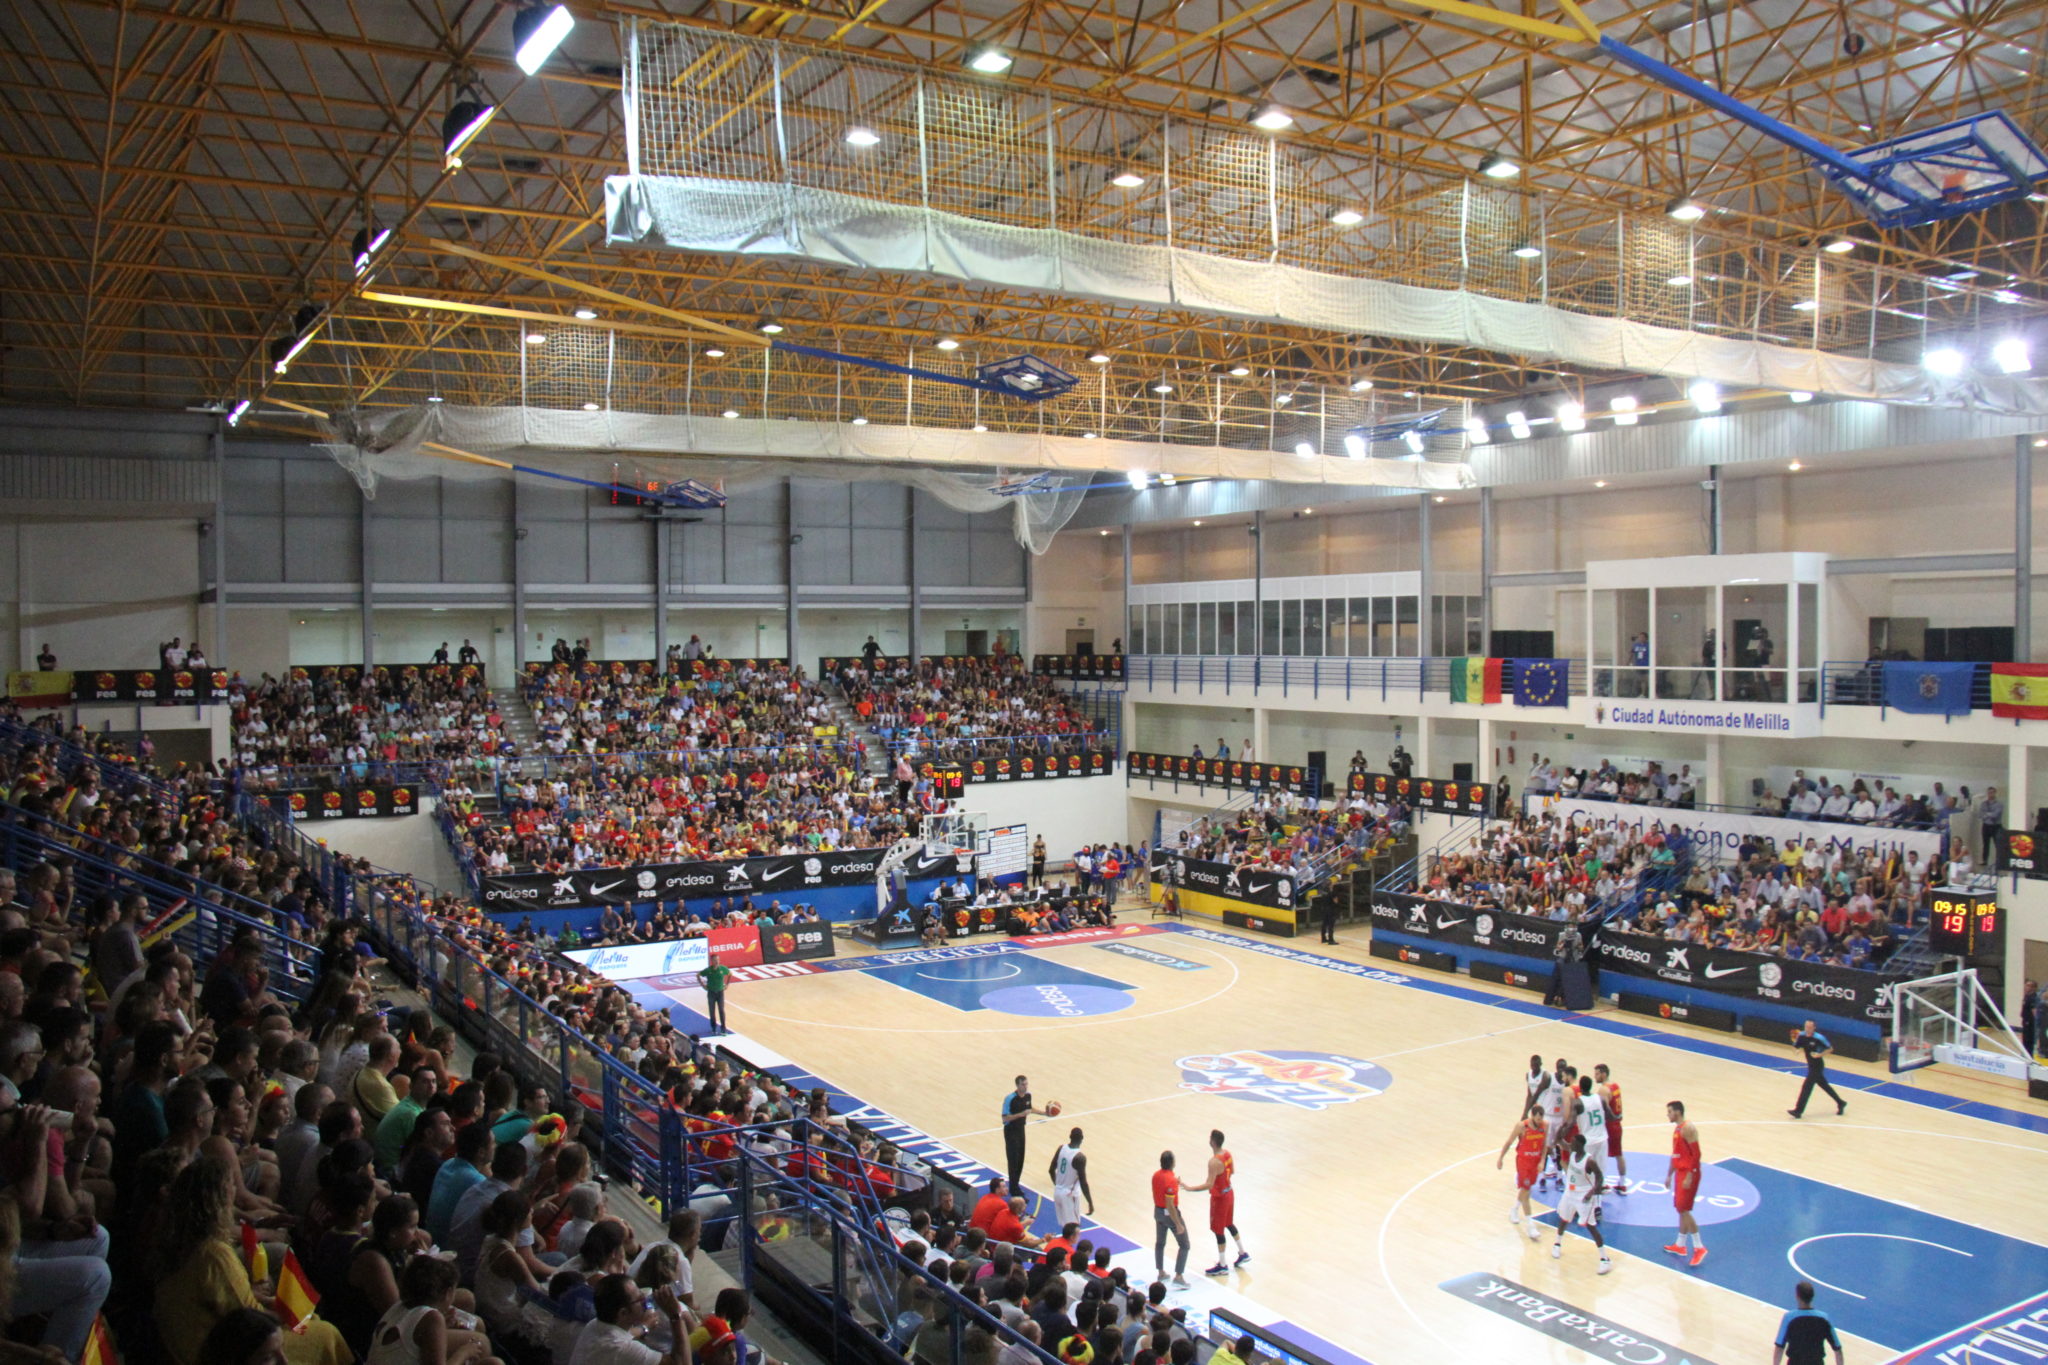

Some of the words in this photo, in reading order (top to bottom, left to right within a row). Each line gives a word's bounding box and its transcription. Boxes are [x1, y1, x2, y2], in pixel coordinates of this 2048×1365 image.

[1612, 707, 1654, 724] Ciudad
[1658, 709, 1723, 728] Autónoma
[1725, 712, 1741, 728] de
[1743, 713, 1790, 731] Melilla
[830, 861, 874, 875] endesa
[1190, 871, 1219, 885] endesa
[486, 887, 538, 900] endesa
[666, 873, 714, 888] endesa
[1371, 903, 1399, 919] ndesa
[1501, 928, 1546, 944] endesa
[1944, 915, 1964, 932] 19
[1025, 930, 1113, 943] IBERIA
[709, 942, 745, 953] IBERIA
[729, 960, 813, 982] FIAT
[1601, 943, 1651, 964] endesa
[1792, 980, 1856, 1000] endesa
[1587, 1109, 1603, 1127] 15
[842, 1104, 993, 1188] MELILLA
[1060, 1157, 1068, 1174] 8
[1475, 1279, 1667, 1364] CaixaBank
